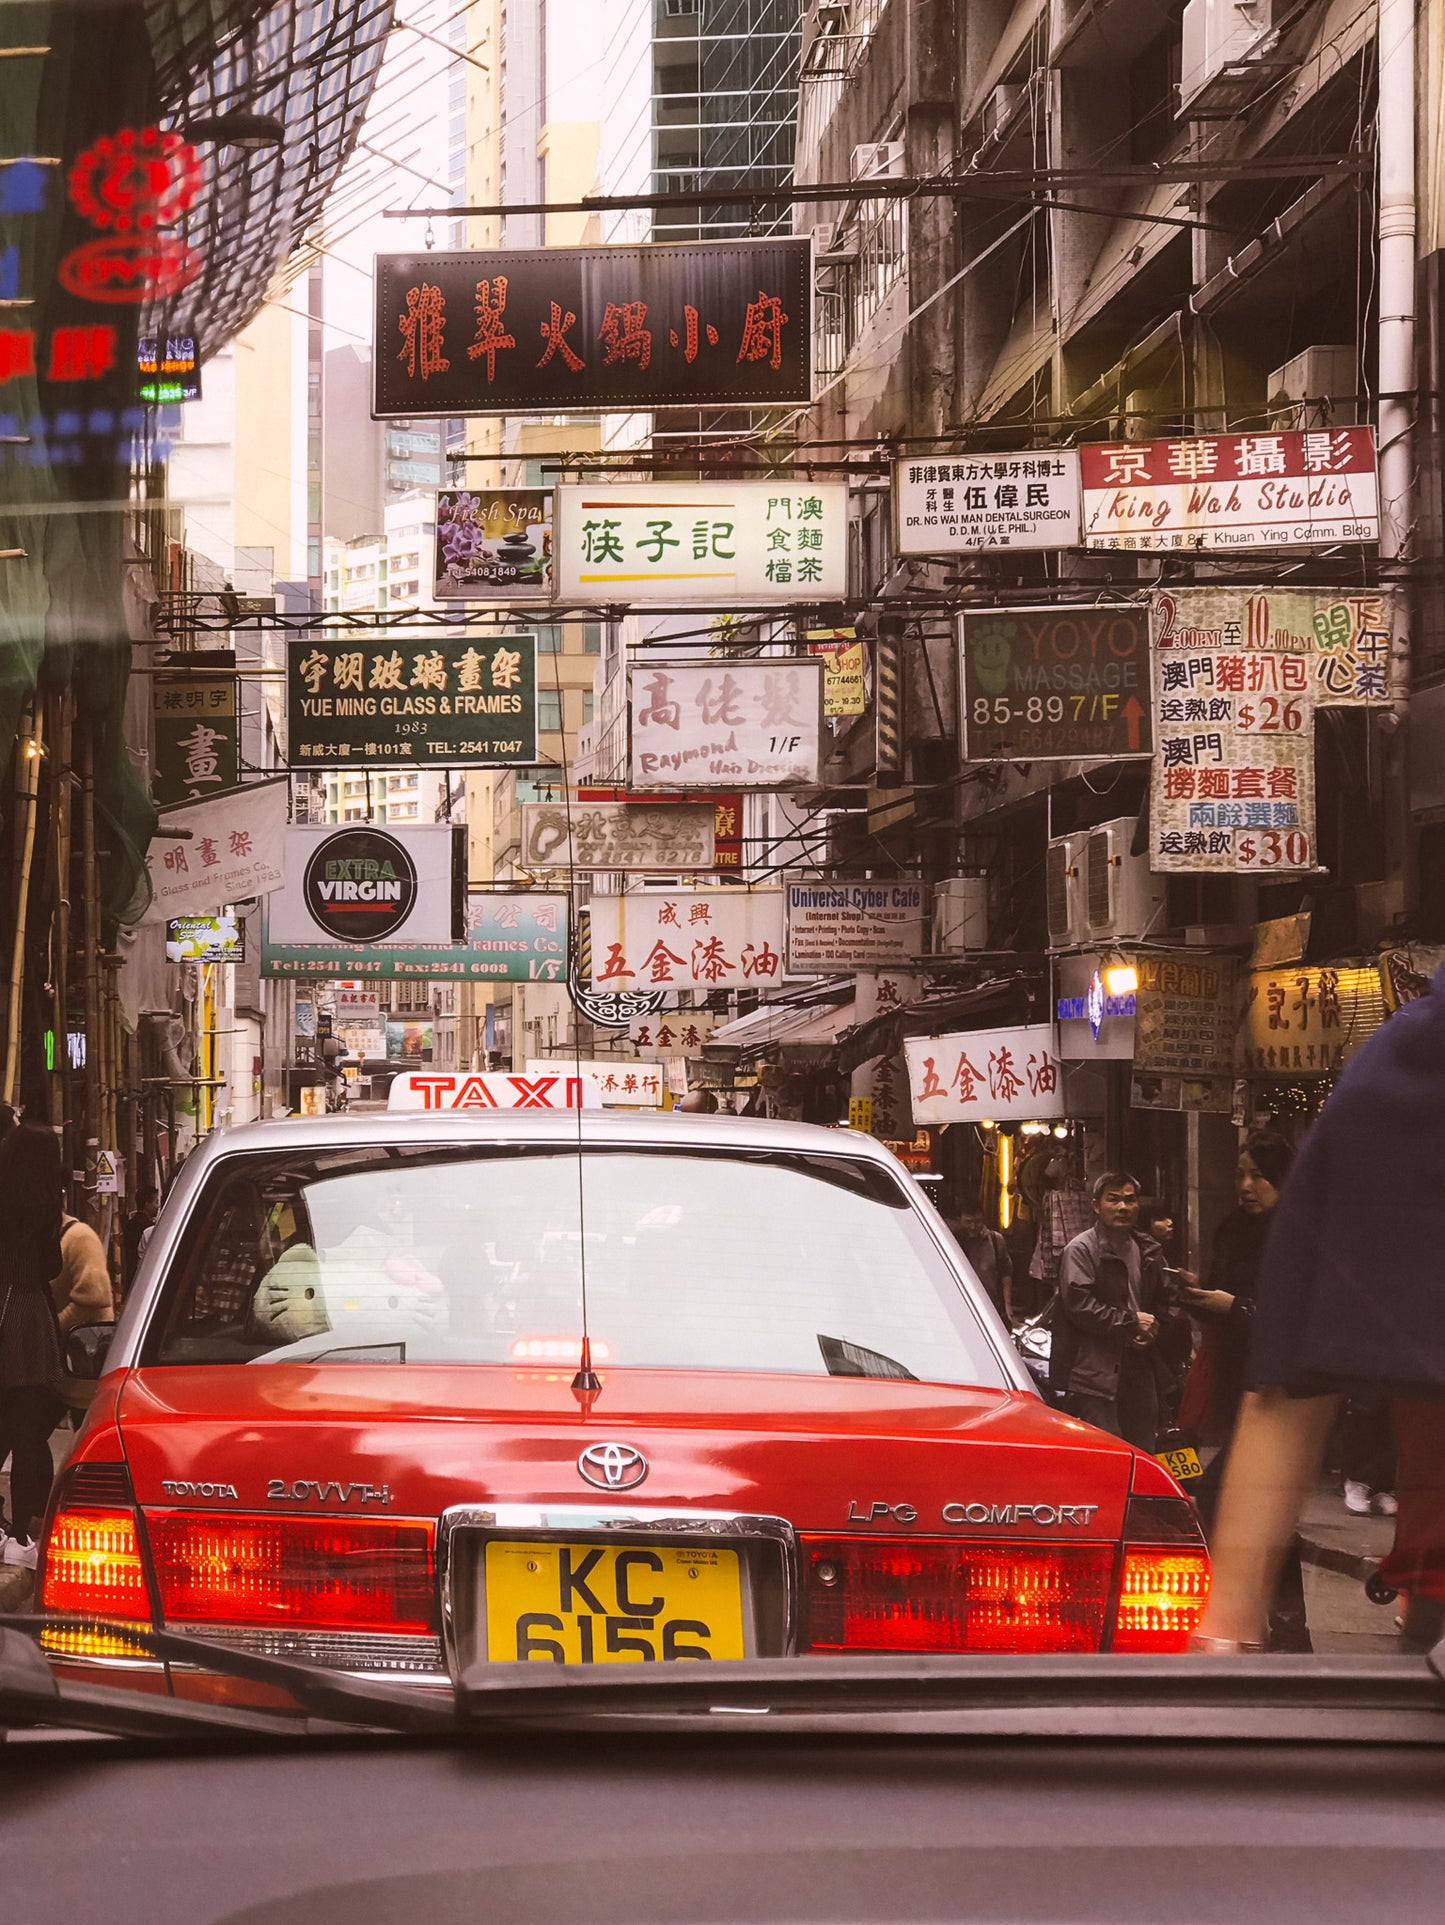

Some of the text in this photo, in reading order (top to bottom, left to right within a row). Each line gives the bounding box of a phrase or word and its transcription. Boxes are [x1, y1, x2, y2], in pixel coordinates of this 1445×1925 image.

[1101, 430, 1354, 485] 京華攝影
[909, 459, 1066, 484] 菲律賓東方大學牙科博士
[963, 483, 1049, 511] 伍偉民
[1108, 477, 1352, 527] King Wah Studio
[449, 501, 539, 528] Fresh Spa
[906, 515, 923, 527] DR.
[924, 514, 938, 526] NG
[940, 513, 959, 525] WAI
[961, 513, 982, 524] MAN
[581, 520, 736, 564] 筷子記
[1214, 528, 1255, 544] Khuan
[1259, 527, 1290, 546] Ying
[1293, 525, 1338, 540] Comm.
[1342, 523, 1371, 537] Bldg
[465, 569, 490, 577] 5408
[492, 567, 516, 576] 1849
[1023, 618, 1137, 660] YOYO
[300, 647, 522, 693] 宇明玻璃畫架
[1013, 661, 1138, 692] MASSAGE
[300, 695, 522, 716] YUE MING GLASS & FRAMES
[973, 694, 1119, 725] 85-89 7/F
[1160, 696, 1302, 730] 送熱飲 $26
[394, 720, 428, 735] 1983
[426, 740, 522, 753] TEL: 2541 7047
[639, 731, 738, 774] Raymond
[769, 736, 800, 752] 1/F
[1161, 733, 1224, 767] 澳門
[1164, 766, 1298, 799] 撈麵套餐
[1159, 831, 1308, 866] 送熱飲 $30
[325, 860, 394, 880] EXTRA
[226, 879, 253, 892] Since
[317, 881, 400, 900] VIRGIN
[792, 887, 920, 909] Universal Cyber Café
[170, 920, 212, 931] Oriental
[657, 901, 713, 928] 成興
[533, 937, 563, 952] Co.
[270, 960, 508, 973] Tel: 2541 7047 Fax: 2541 6008
[596, 936, 778, 983] 五金漆油
[917, 1046, 1057, 1103] 五金漆油
[410, 1077, 583, 1108] TAXI
[1165, 1452, 1186, 1466] KD
[1172, 1463, 1200, 1477] 580
[162, 1481, 238, 1499] TOYOTA
[847, 1501, 1098, 1526] LPG COMFORT
[559, 1548, 665, 1617] KC
[516, 1613, 712, 1664] 6156
